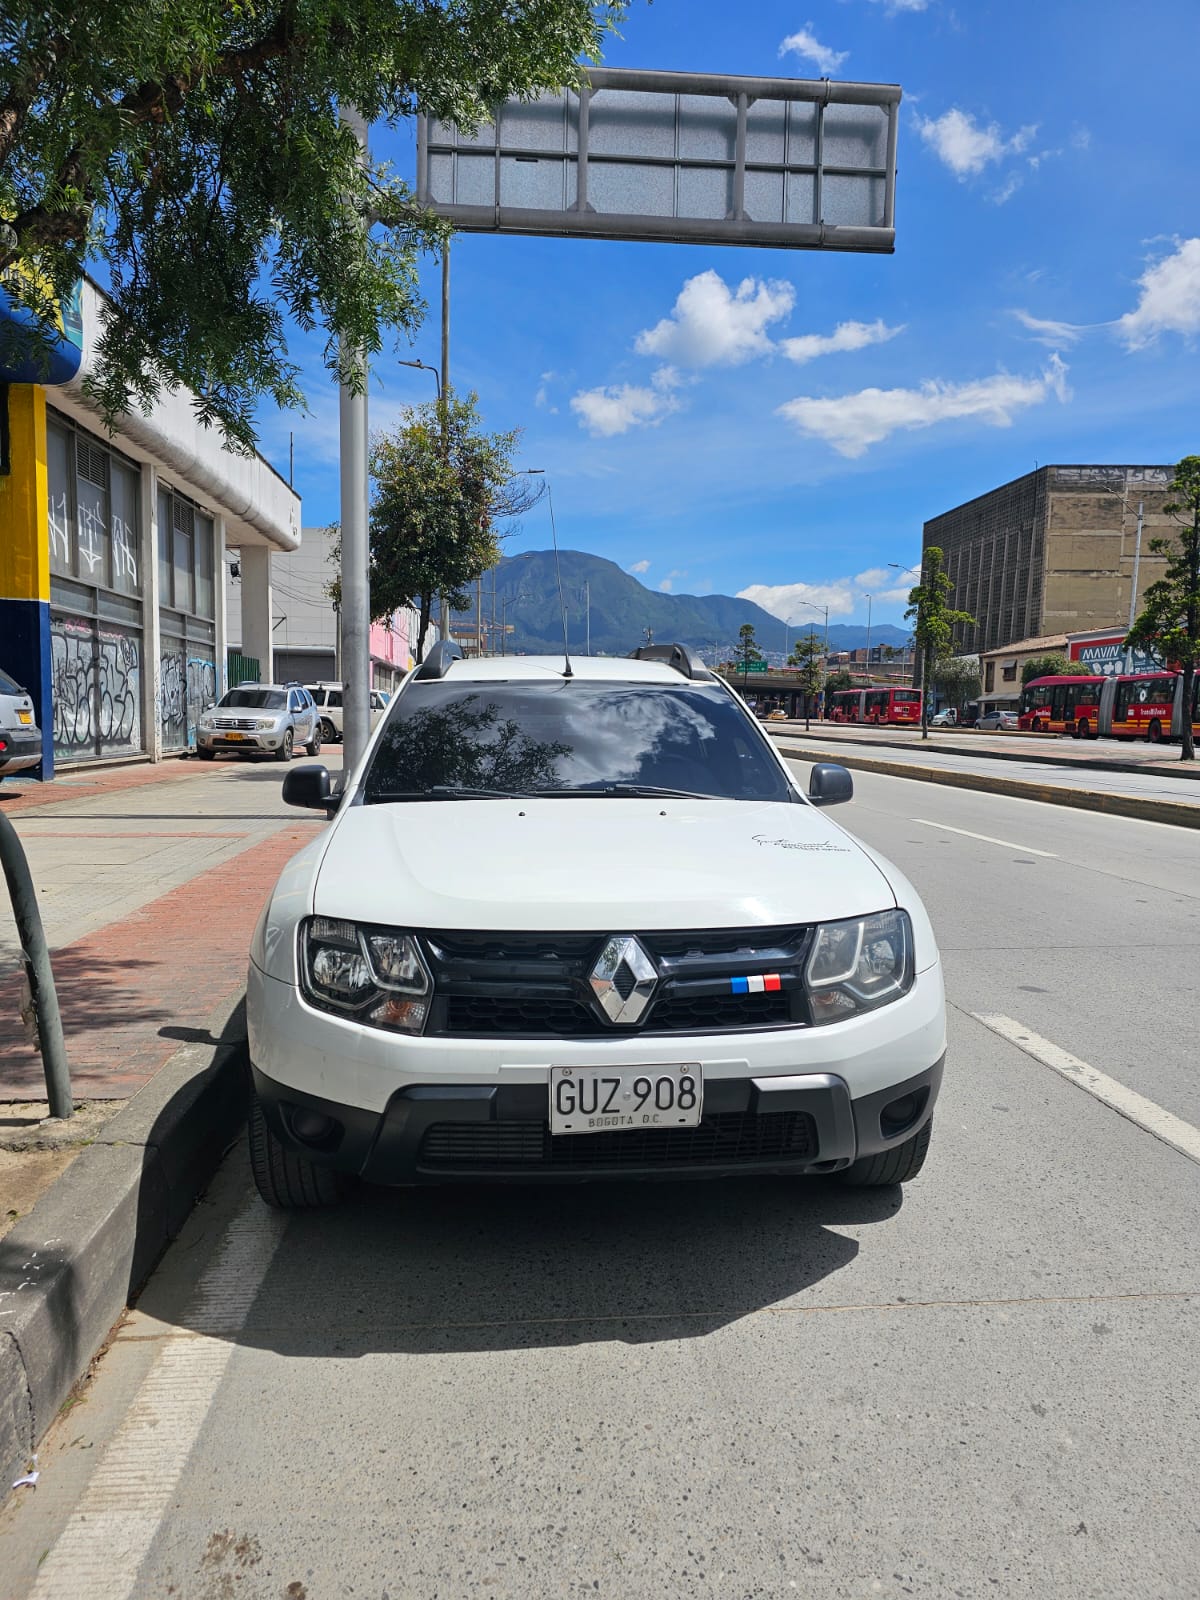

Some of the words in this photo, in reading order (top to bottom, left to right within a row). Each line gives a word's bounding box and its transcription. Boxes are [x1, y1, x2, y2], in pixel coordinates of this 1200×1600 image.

[1082, 645, 1120, 660] MAVIN
[556, 1078, 621, 1116] GUZ
[632, 1075, 697, 1112] 908
[588, 1116, 634, 1128] BOGOTA
